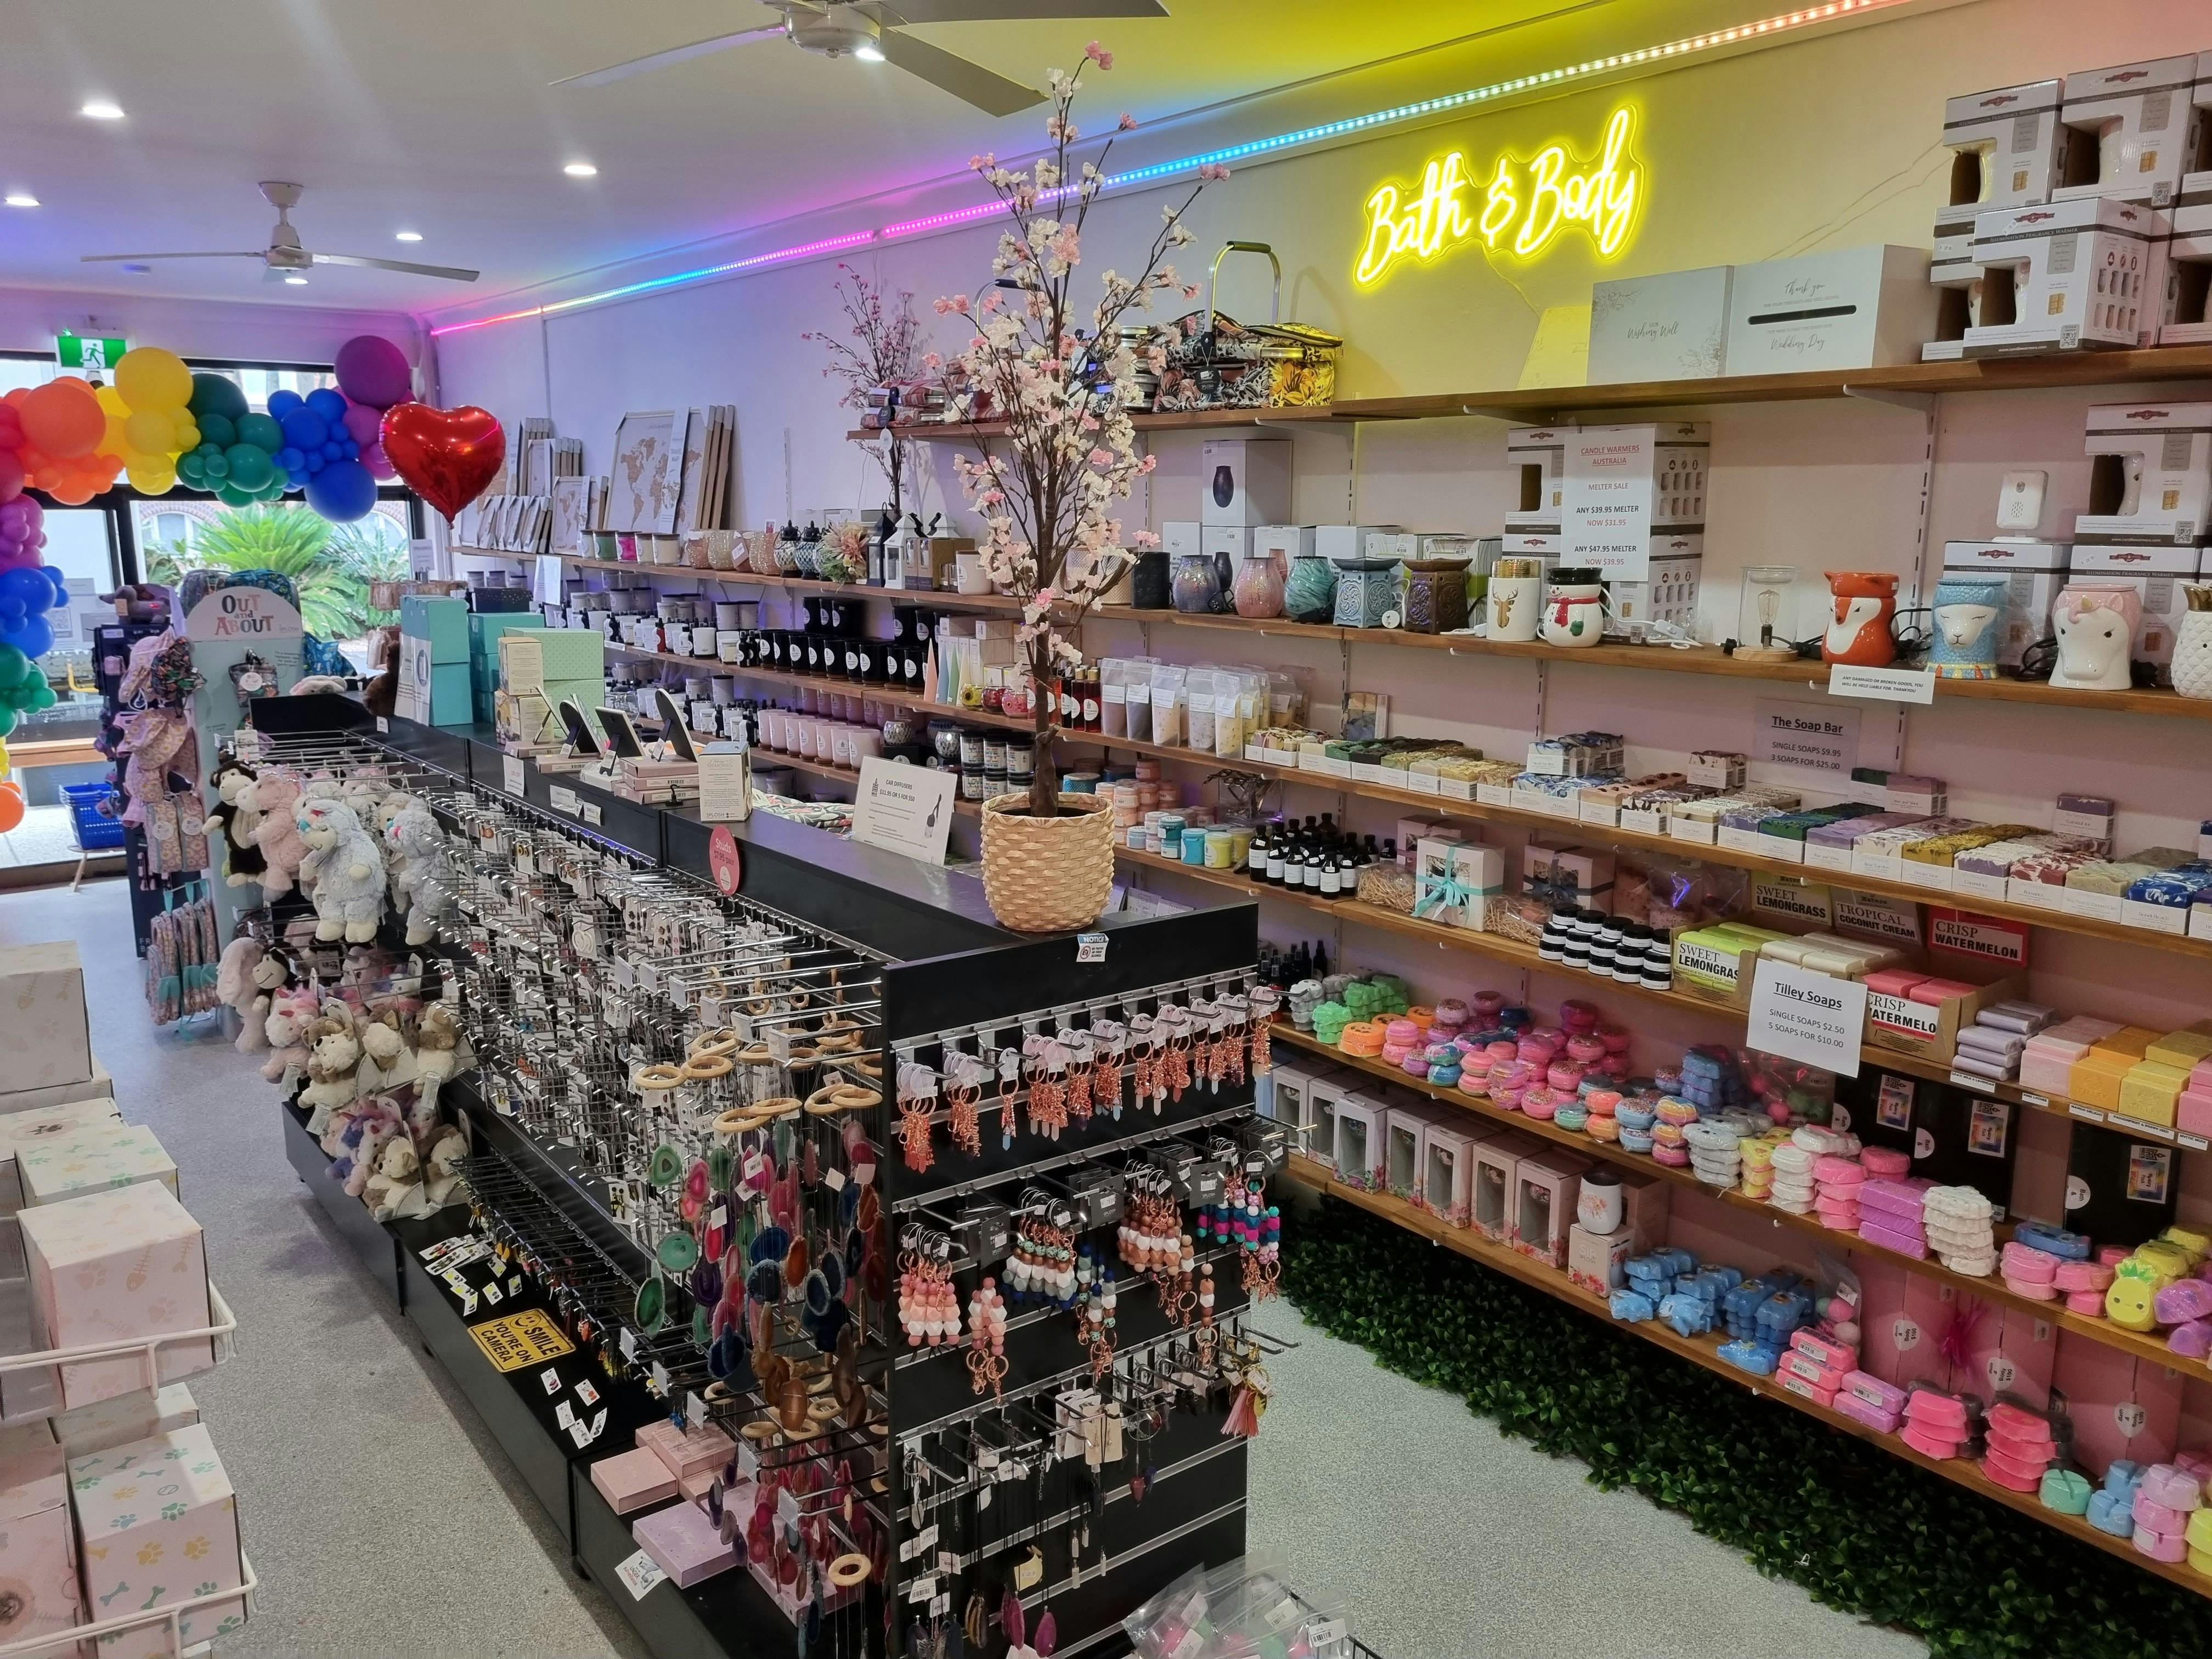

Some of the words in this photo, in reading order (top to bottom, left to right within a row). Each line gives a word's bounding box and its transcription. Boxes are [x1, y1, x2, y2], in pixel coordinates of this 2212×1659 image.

[1356, 151, 1472, 283] Bath
[1480, 159, 1517, 247] &
[1515, 109, 1637, 255] Body
[1990, 234, 2025, 243] ILLUMINATION
[2025, 230, 2056, 240] FRAGRANCE
[1785, 278, 1810, 296] Thank
[1810, 283, 1826, 297] you
[1627, 323, 1657, 341] Wishing
[1659, 321, 1679, 336] Well
[1770, 335, 1805, 354] Wedding
[1808, 334, 1826, 352] Day
[1581, 446, 1605, 455] CANDLE
[1607, 444, 1640, 454] WARMERS
[1593, 457, 1627, 465] AUSTRALIA
[1591, 505, 1612, 514] $39.95
[1613, 505, 1639, 513] MELTER
[1605, 518, 1626, 527] $31.95
[1589, 545, 1610, 554] $47.95
[1611, 545, 1637, 553] MELTER
[1602, 557, 1624, 566] $39.95
[222, 594, 261, 614] OUT
[234, 610, 254, 618] and
[215, 614, 274, 636] ABOUT
[1771, 715, 1792, 728] The
[1795, 718, 1821, 733] Soap
[1825, 721, 1843, 734] Bar
[1771, 741, 1796, 751] SINGLE
[1797, 744, 1820, 755] SOAPS
[1821, 747, 1841, 757] $9.95
[1777, 754, 1799, 764] SOAPS
[1800, 757, 1814, 766] FOR
[1816, 759, 1840, 770] $25.00
[894, 781, 912, 790] DIFFUSERS
[715, 838, 731, 854] Studs
[714, 850, 725, 862] $7.95
[1756, 884, 1797, 901] SWEET
[1756, 895, 1826, 918] LEMONGRASS
[1837, 902, 1906, 926] TROPICAL
[1839, 915, 1880, 930] COCONUT
[1882, 923, 1915, 939] CREAM
[1936, 921, 1978, 939] CRISP
[1679, 943, 1720, 963] SWEET
[1935, 933, 2018, 960] WATERMELON
[1679, 954, 1739, 980] LEMONGRAS
[1775, 981, 1804, 1000] Tilley
[1807, 991, 1842, 1008] Soaps
[1867, 993, 1905, 1012] CRISP
[1769, 1008, 1795, 1022] SINGLE
[1797, 1016, 1821, 1028] SOAPS
[1822, 1023, 1845, 1034] $2.50
[1869, 1007, 1937, 1034] ATERMELO
[1775, 1024, 1799, 1036] SOAPS
[1800, 1031, 1815, 1041] FOR
[1817, 1035, 1844, 1048] $10.00
[481, 1329, 514, 1363] CAMERA
[493, 1321, 523, 1350] YOU'RE
[516, 1349, 534, 1363] ON
[523, 1326, 562, 1356] SMILE
[629, 1566, 640, 1578] UNDER
